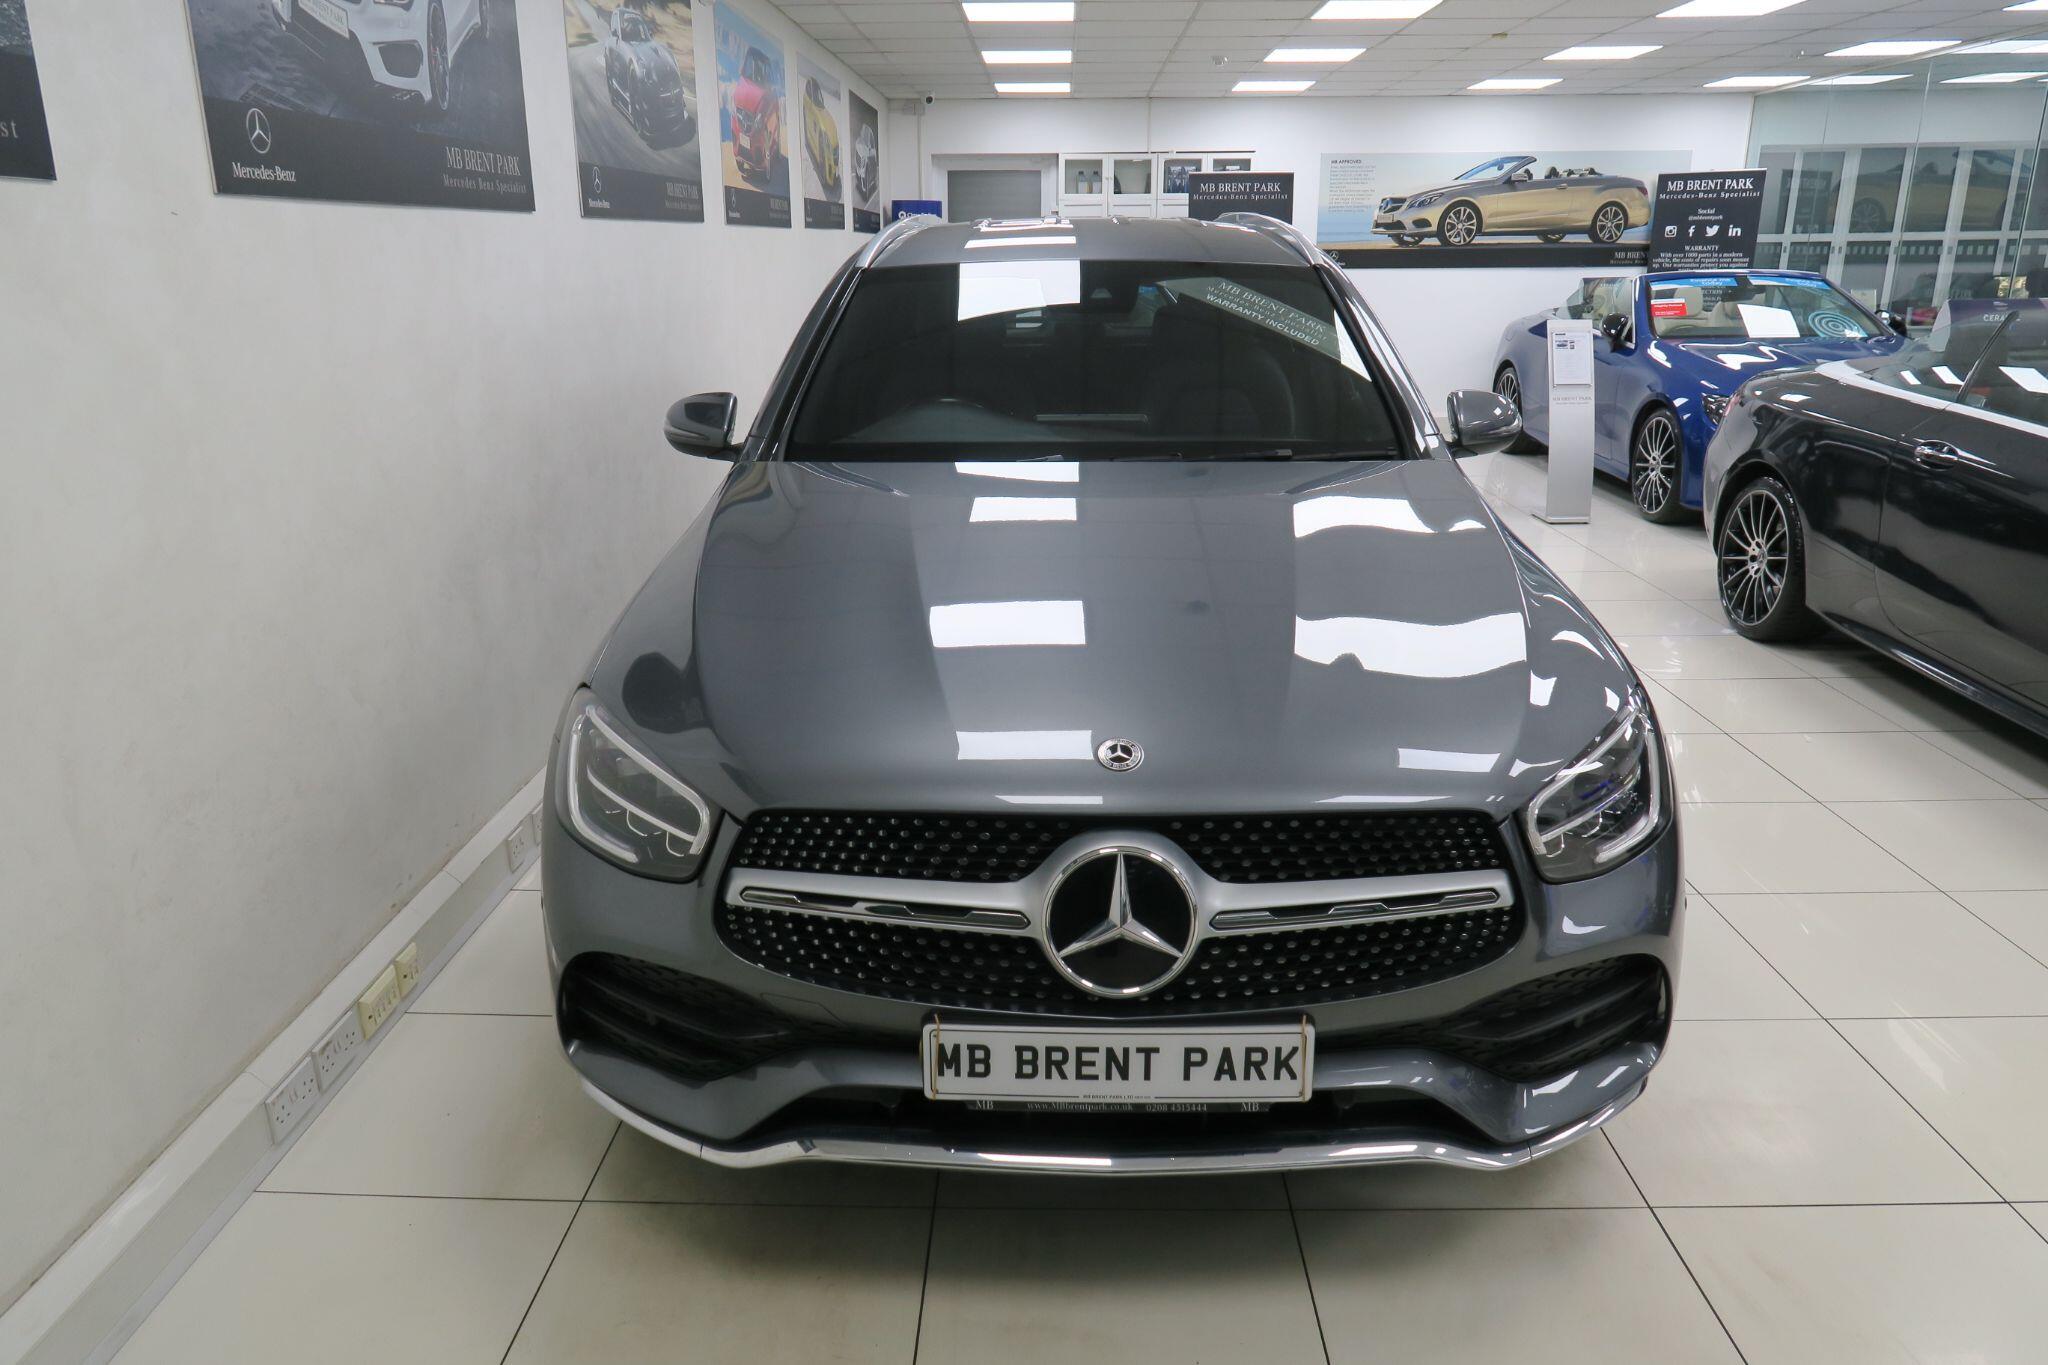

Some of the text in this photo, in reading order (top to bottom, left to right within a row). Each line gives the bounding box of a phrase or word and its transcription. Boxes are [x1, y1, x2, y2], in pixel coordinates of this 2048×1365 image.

[231, 161, 297, 182] Mercedes-Benz
[446, 146, 521, 176] MB BRENT PARK
[443, 173, 477, 190] Mercedes
[496, 179, 527, 195] Specialist
[1200, 182, 1281, 193] MB BRENT PARK
[1667, 178, 1754, 192] MB BRENT PARK
[1251, 193, 1288, 201] Specialist
[1660, 191, 1760, 200] Mercedes-Benz Specialist
[1218, 281, 1327, 333] MB BRENT PARK
[1206, 293, 1320, 346] WARRANTY INCLUDED
[937, 1043, 1299, 1081] MB BRENT PARK
[975, 1100, 994, 1110] MB
[1146, 1103, 1168, 1112] 0208
[1240, 1102, 1260, 1112] MB
